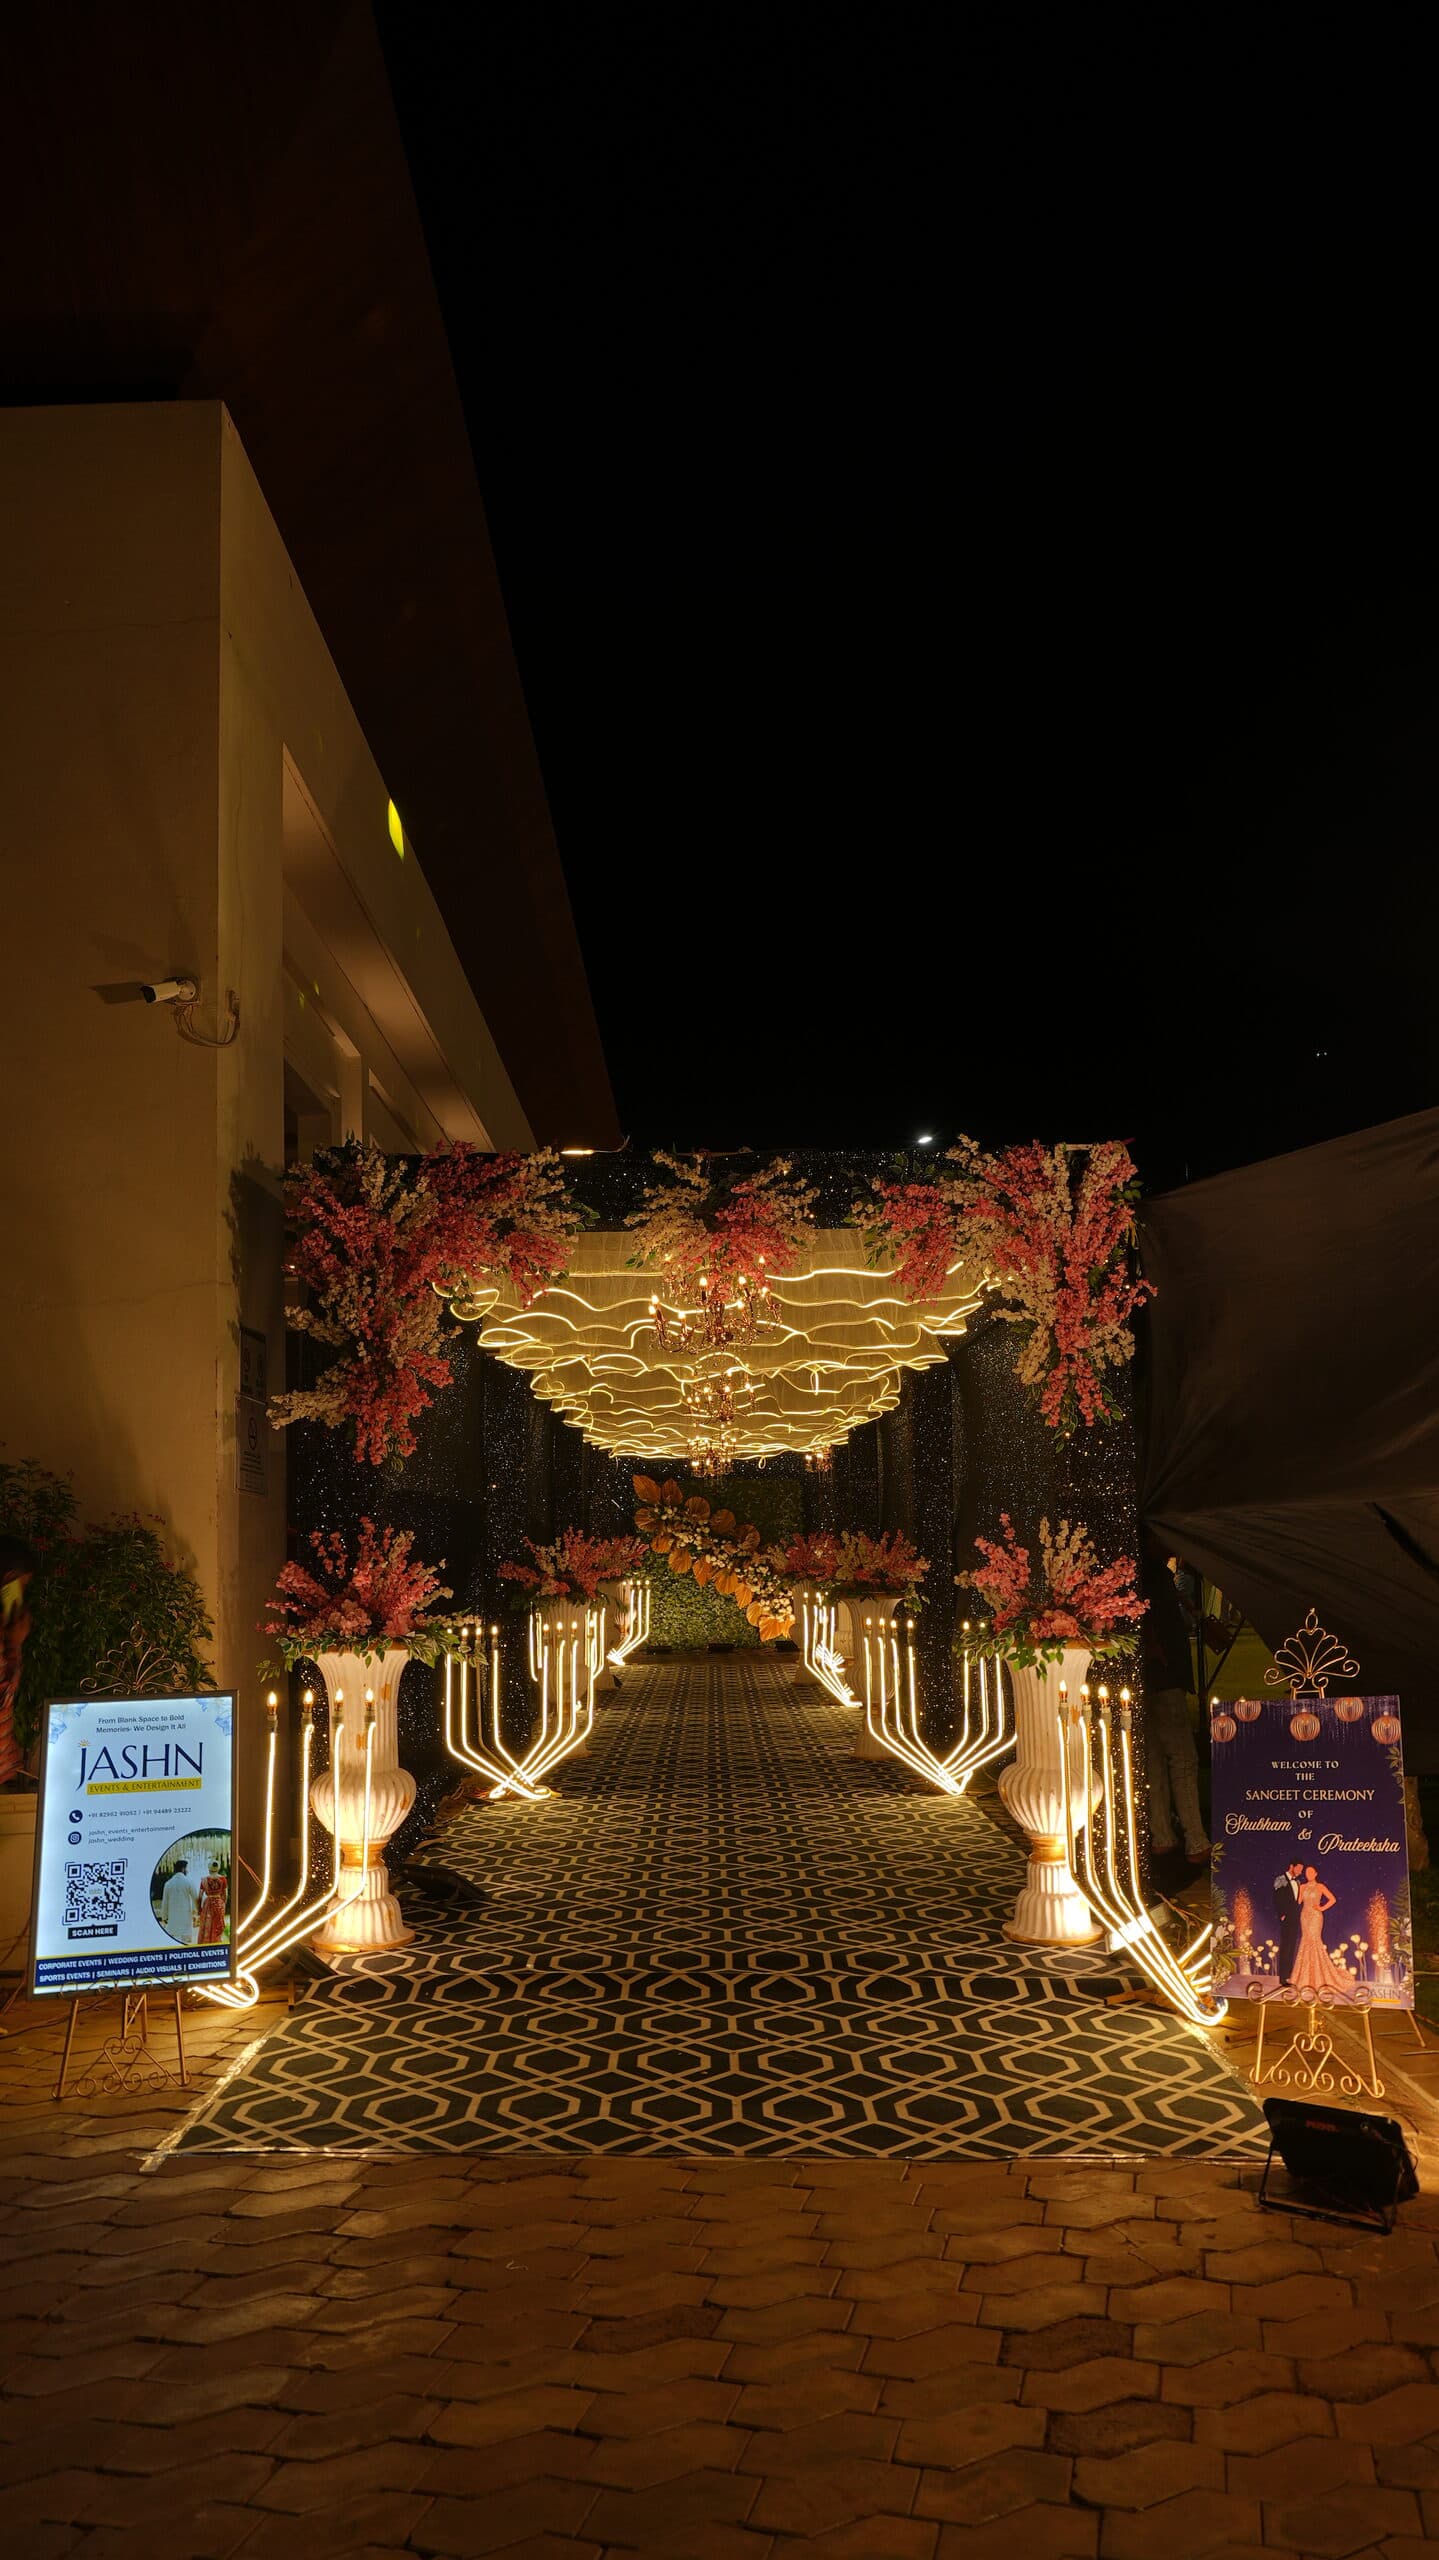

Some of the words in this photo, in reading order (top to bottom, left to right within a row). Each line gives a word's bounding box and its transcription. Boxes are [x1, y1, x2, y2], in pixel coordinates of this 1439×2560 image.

[139, 1714, 160, 1723] Space
[133, 1724, 145, 1732] We
[146, 1724, 169, 1732] Design
[76, 1742, 203, 1792] JASHN
[1271, 1761, 1322, 1769] WELCOME
[1325, 1760, 1340, 1769] TO
[1295, 1773, 1315, 1781] THE
[89, 1784, 120, 1793] EVENTS
[121, 1783, 129, 1791] &
[131, 1779, 200, 1791] ENTERTAINMENT
[1245, 1790, 1301, 1801] SANGEET
[1303, 1789, 1375, 1801] CEREMONY
[1298, 1810, 1314, 1819] OF
[1225, 1812, 1293, 1836] Shubham
[1297, 1828, 1313, 1841] &
[1317, 1833, 1401, 1855] Prateeksha
[71, 1928, 94, 1937] SCAN
[95, 1927, 114, 1935] HERE
[39, 1961, 77, 1970] CORPORATE
[78, 1959, 102, 1968] EVENTS
[108, 1956, 138, 1965] WEDDING
[140, 1954, 164, 1962] EVENTS
[169, 1951, 200, 1960] POLITICAL
[201, 1949, 225, 1957] EVENTS
[39, 1973, 65, 1982] SPORTS
[66, 1971, 90, 1980] EVENTS
[96, 1968, 130, 1977] SEMINARS
[135, 1966, 156, 1975] AUDIO
[156, 1964, 182, 1972] VISUALS
[188, 1960, 227, 1970] EXHIBITIONS
